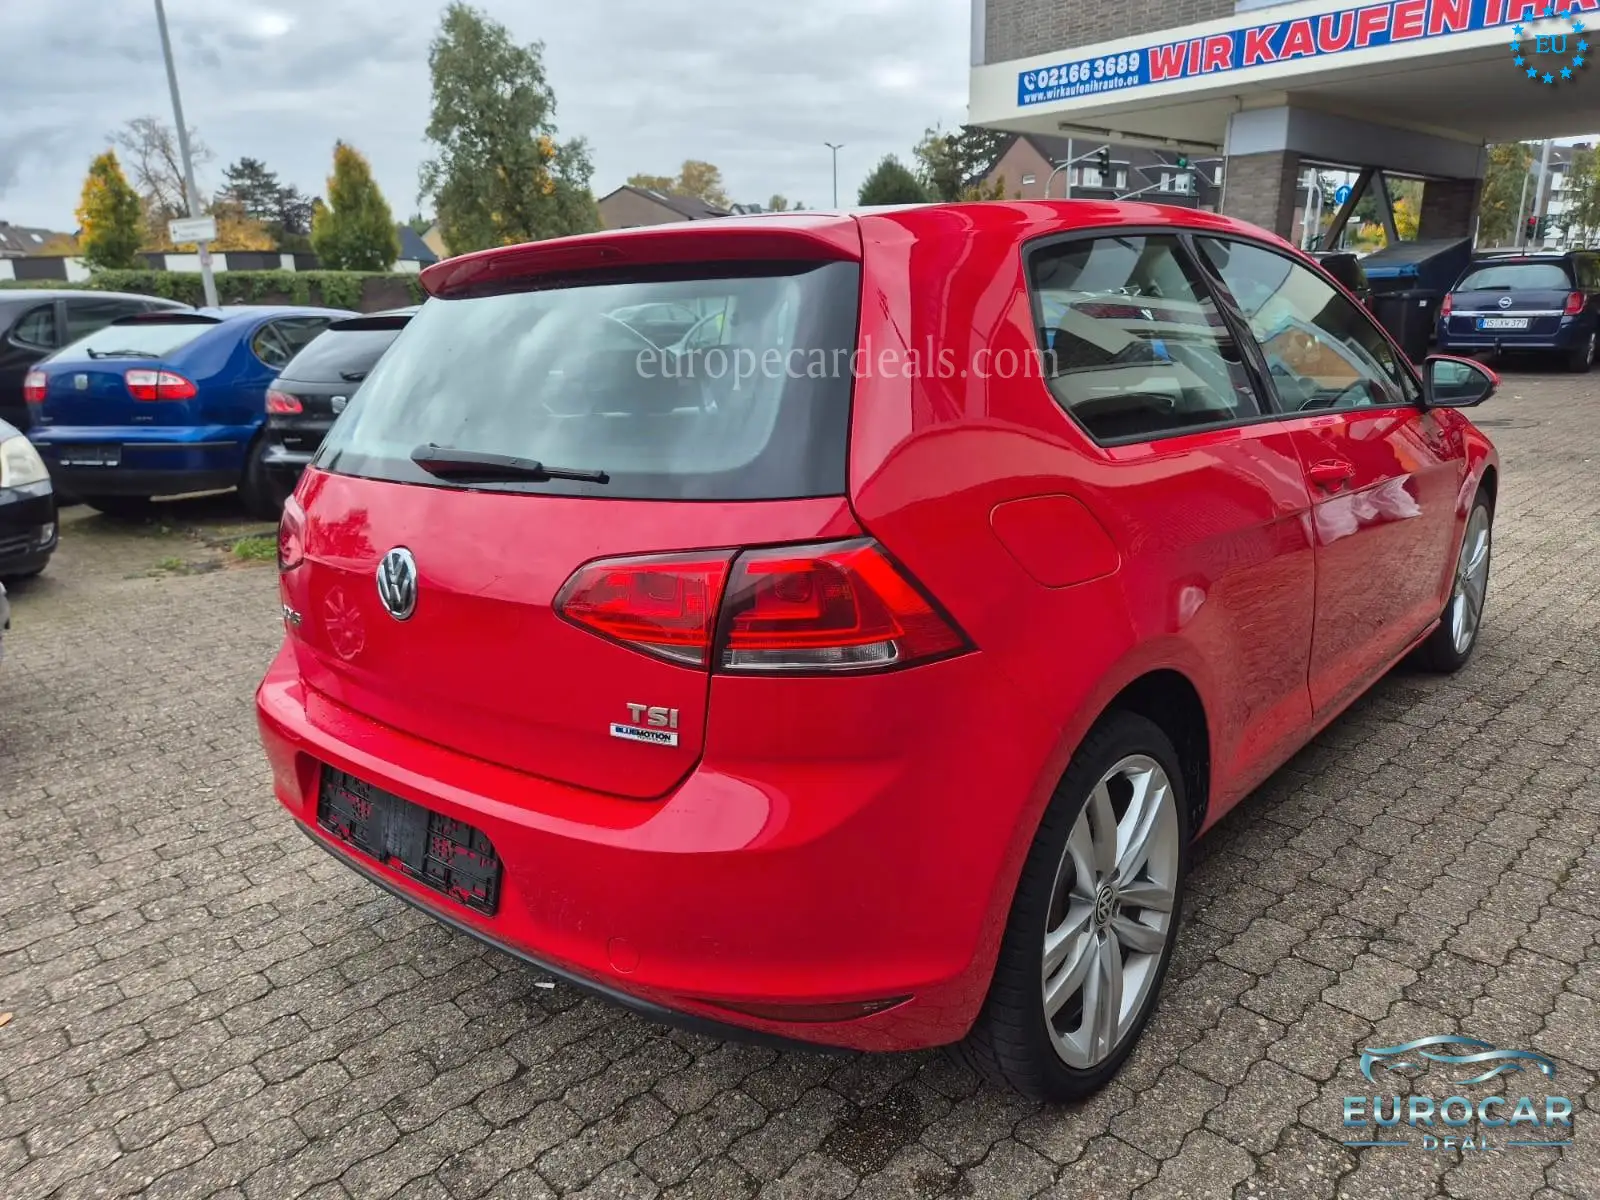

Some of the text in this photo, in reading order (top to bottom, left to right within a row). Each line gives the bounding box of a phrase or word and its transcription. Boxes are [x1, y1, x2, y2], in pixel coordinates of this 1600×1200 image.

[1148, 0, 1599, 82] WIR KAUFEN IH
[1037, 52, 1140, 89] 02166 3689
[1023, 74, 1139, 104] www.wirkaufenihrauto.eu
[626, 702, 678, 728] TSI
